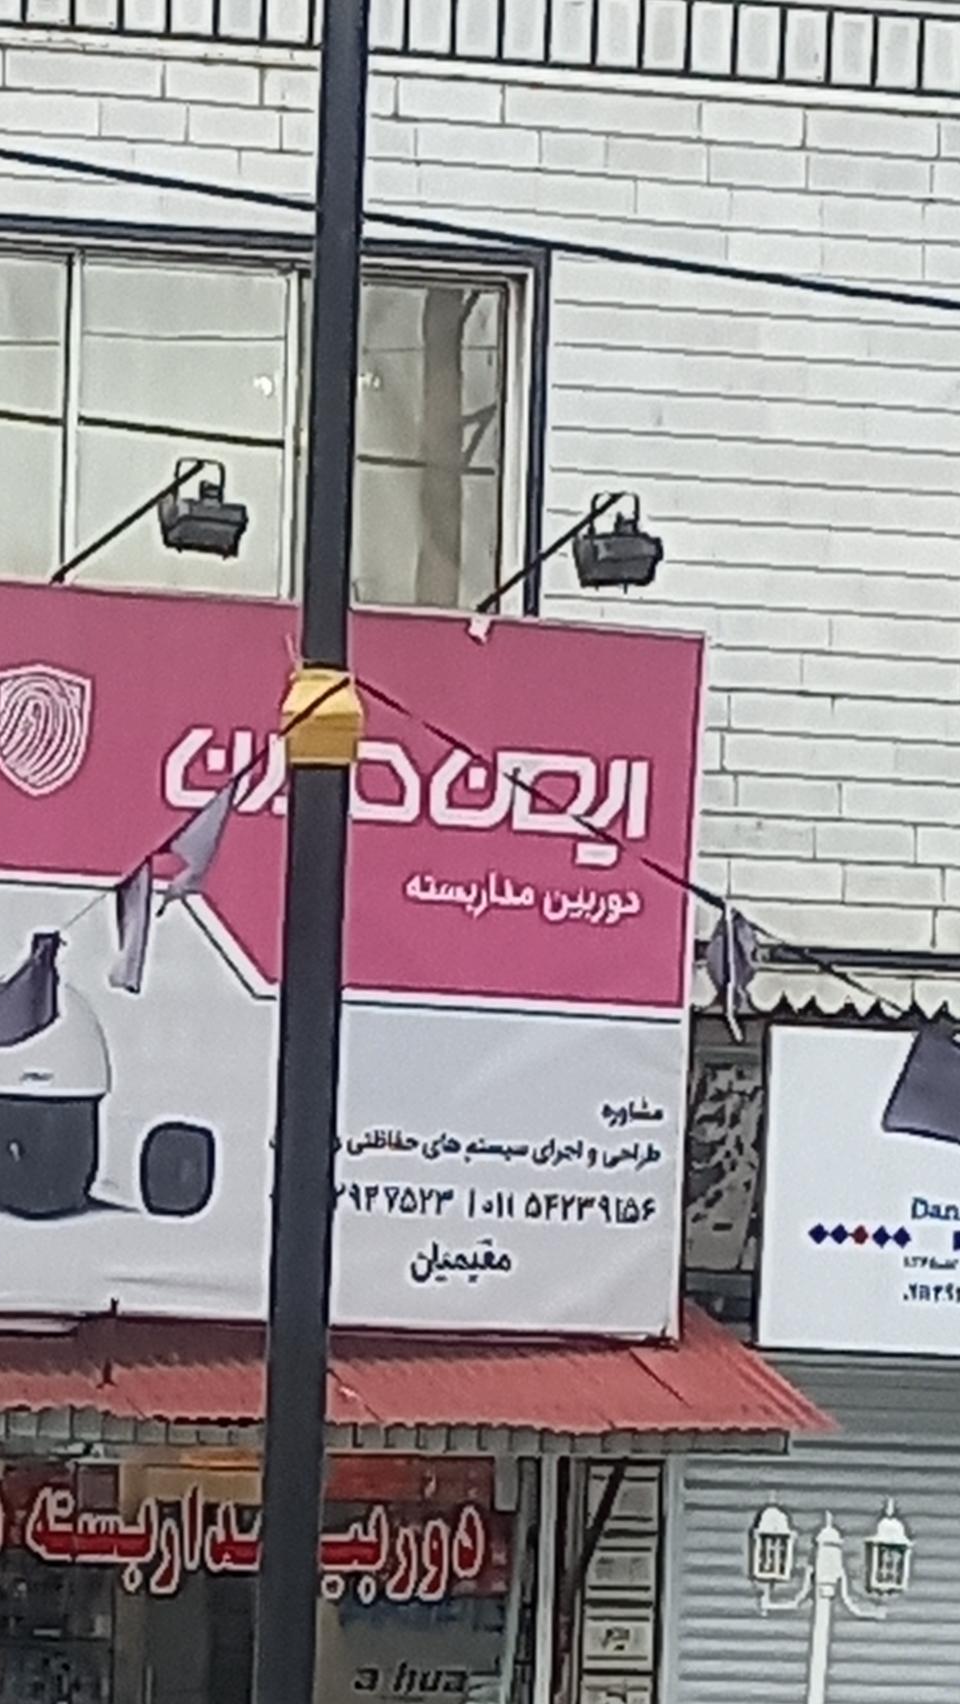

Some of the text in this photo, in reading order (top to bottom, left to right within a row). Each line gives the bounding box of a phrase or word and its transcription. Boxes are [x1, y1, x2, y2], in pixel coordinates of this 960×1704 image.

[405, 870, 641, 925] دوربین مداربسته
[601, 1096, 664, 1127] مشاوره
[346, 1130, 419, 1157] حفاظتی
[421, 1132, 461, 1160] های
[532, 1137, 583, 1166] اجرای
[587, 1146, 598, 1168] و
[603, 1141, 662, 1170] طراحی
